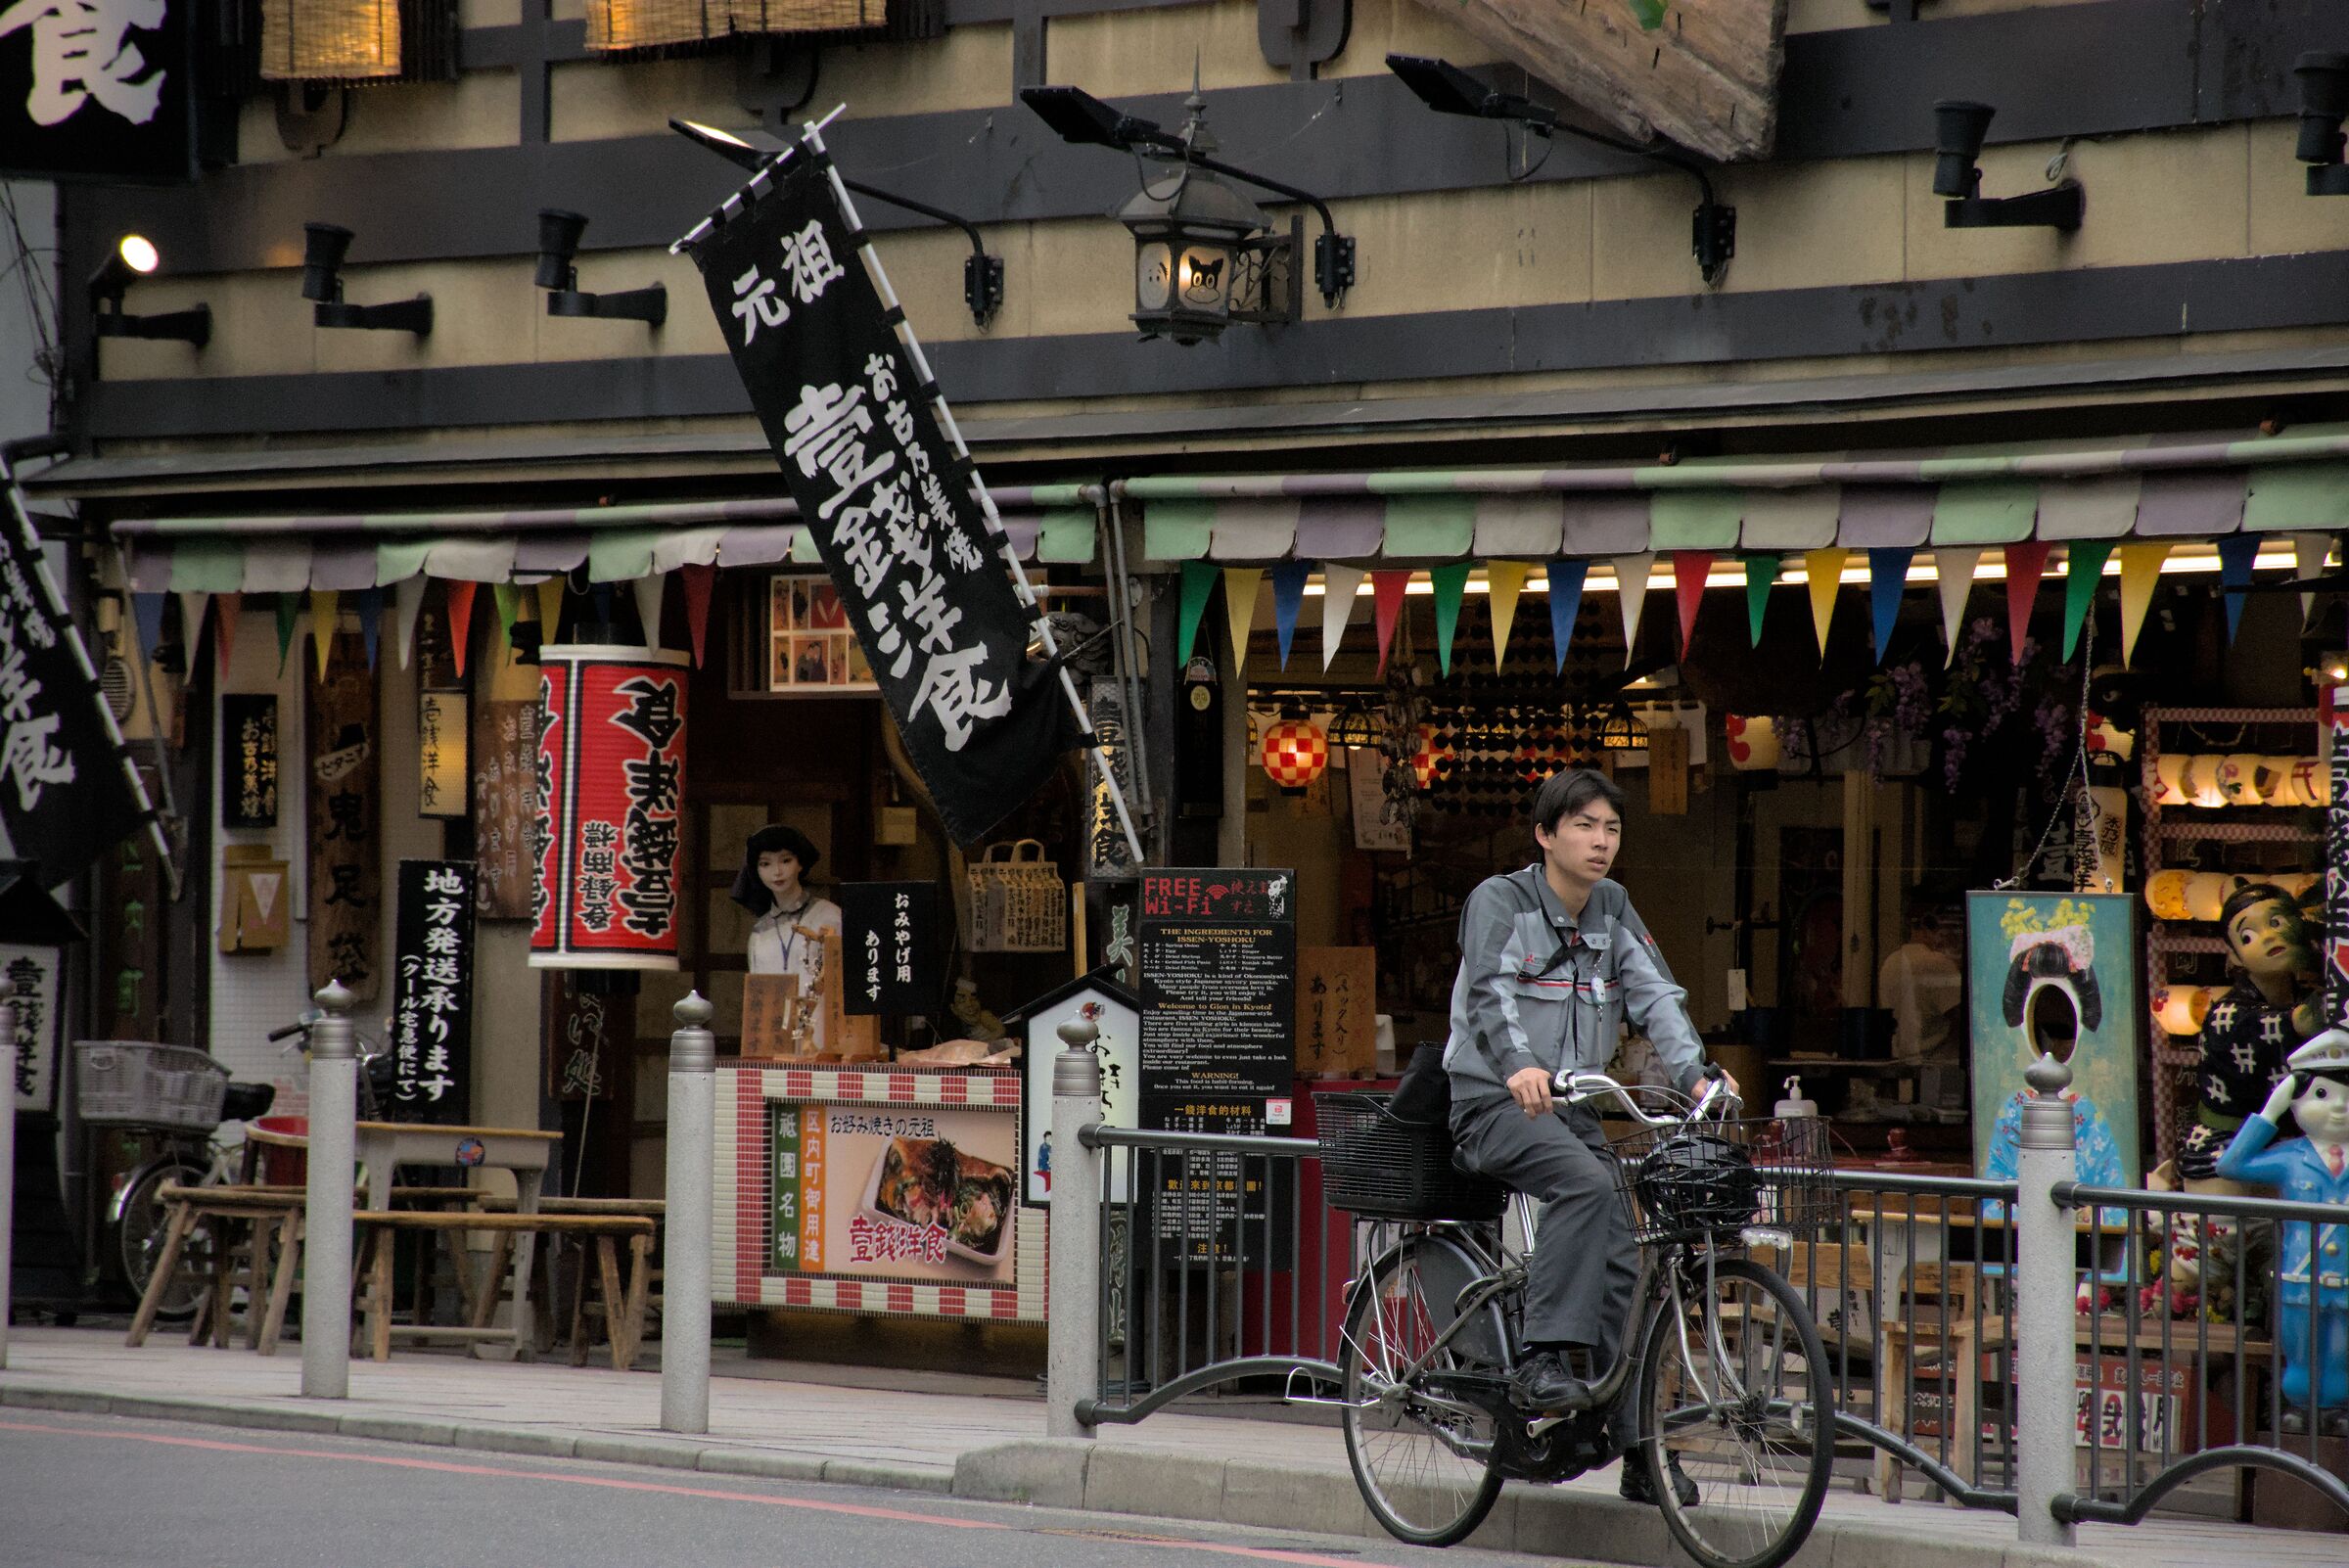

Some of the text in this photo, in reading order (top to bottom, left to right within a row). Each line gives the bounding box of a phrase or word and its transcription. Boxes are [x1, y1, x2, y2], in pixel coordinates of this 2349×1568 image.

[731, 219, 846, 346] 元祖
[0, 590, 77, 813] 洋食
[1145, 877, 1201, 898] FREE
[1145, 896, 1213, 916] Wi-Fi
[864, 929, 882, 1002] あります
[894, 892, 912, 984] おみやげ用
[420, 867, 463, 1103] 地方発送承ります
[830, 1116, 936, 1137] お好み焼きの元祖
